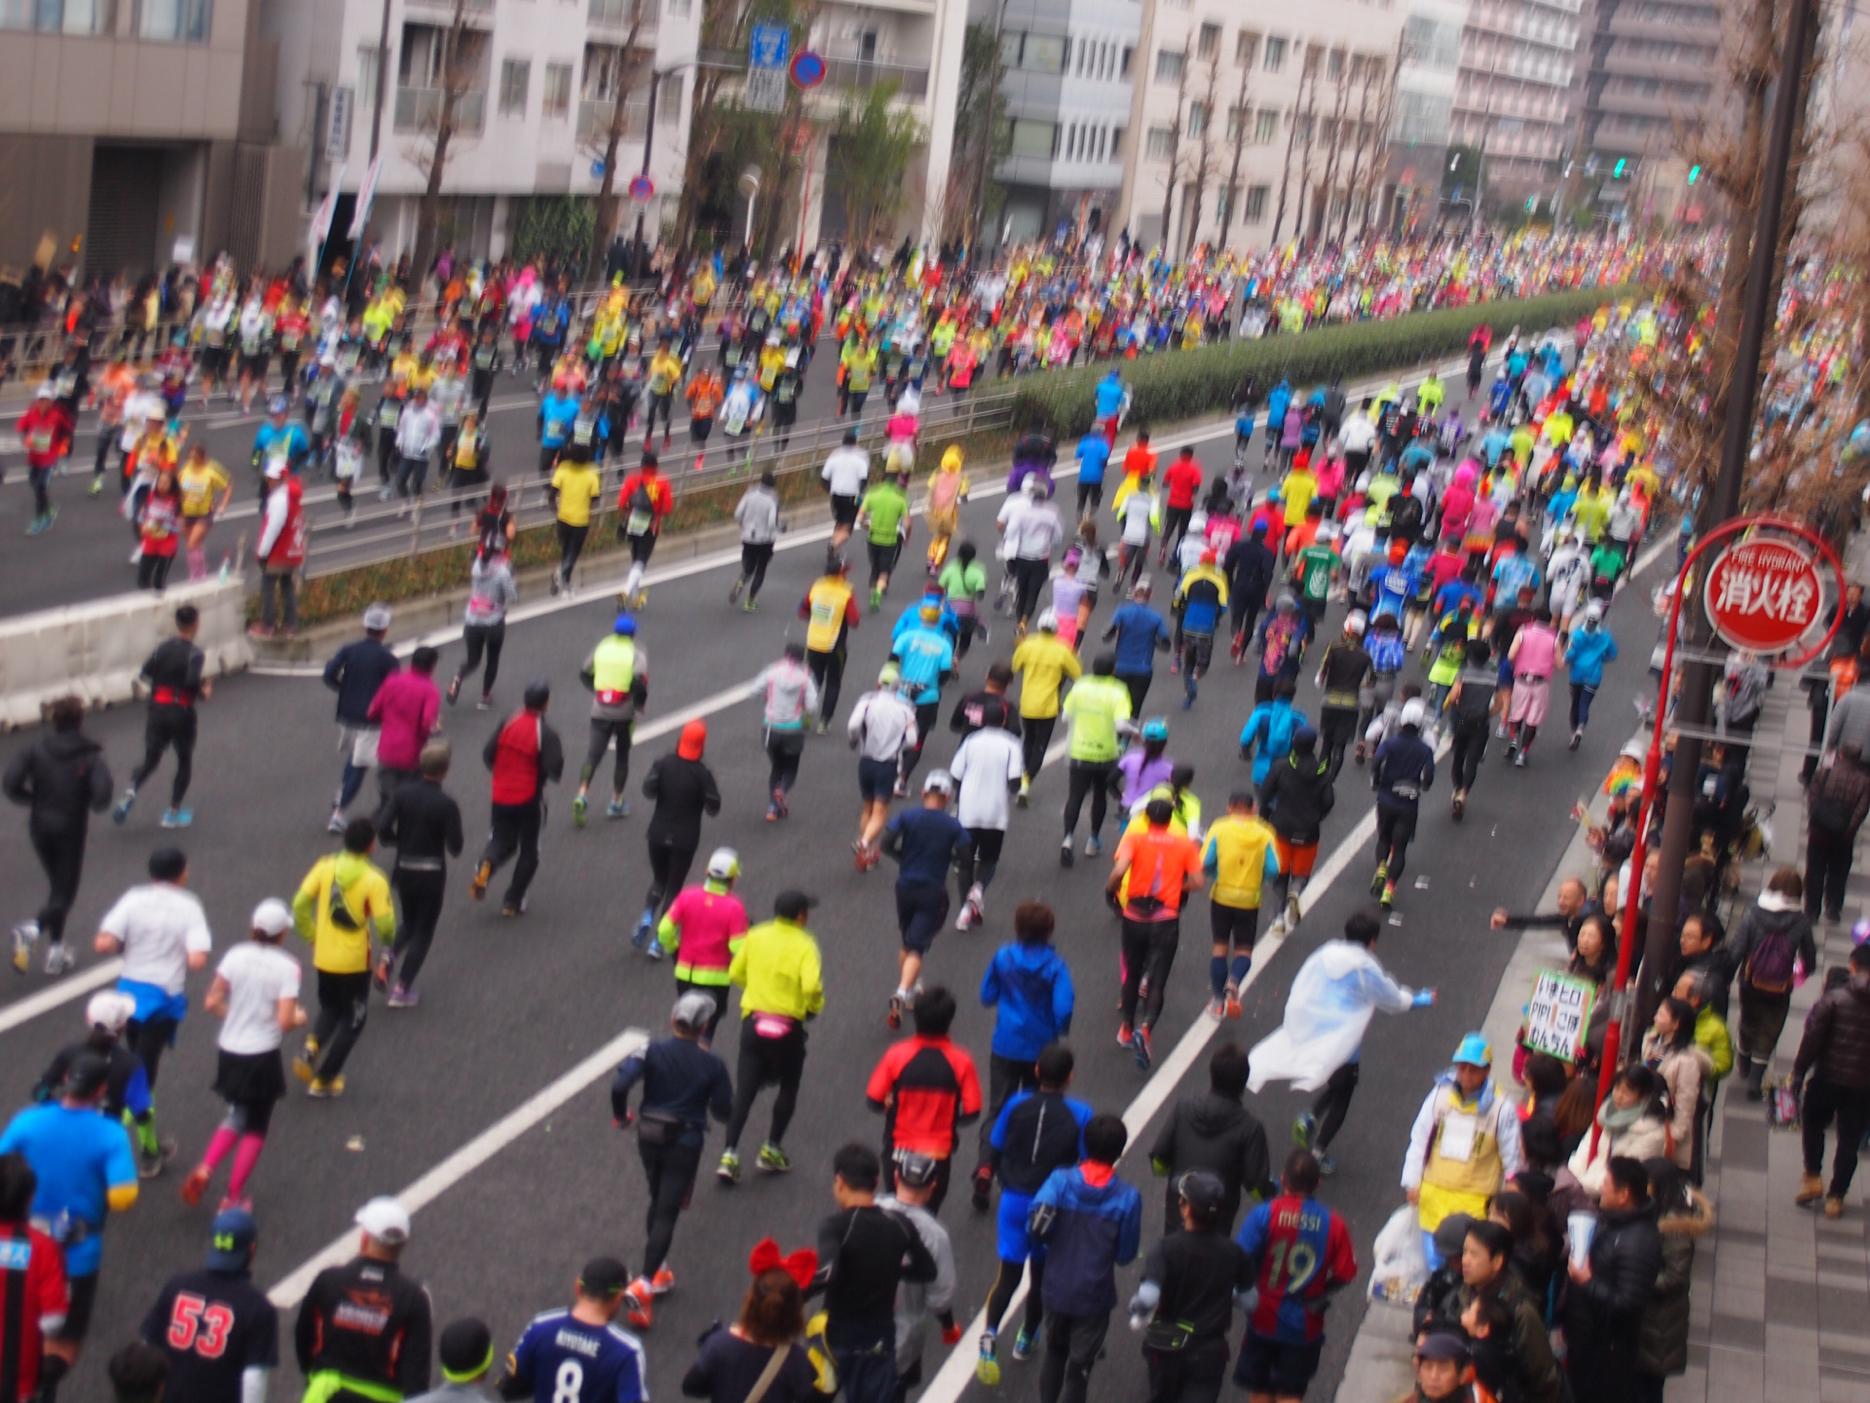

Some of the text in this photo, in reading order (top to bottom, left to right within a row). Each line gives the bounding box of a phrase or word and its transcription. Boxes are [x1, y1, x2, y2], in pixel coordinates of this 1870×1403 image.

[1731, 549, 1807, 573] FIRE HYDRANT
[1715, 566, 1815, 624] 消火栓
[1268, 1238, 1316, 1294] 19
[167, 1292, 235, 1359] 53
[552, 1358, 583, 1403] 8
